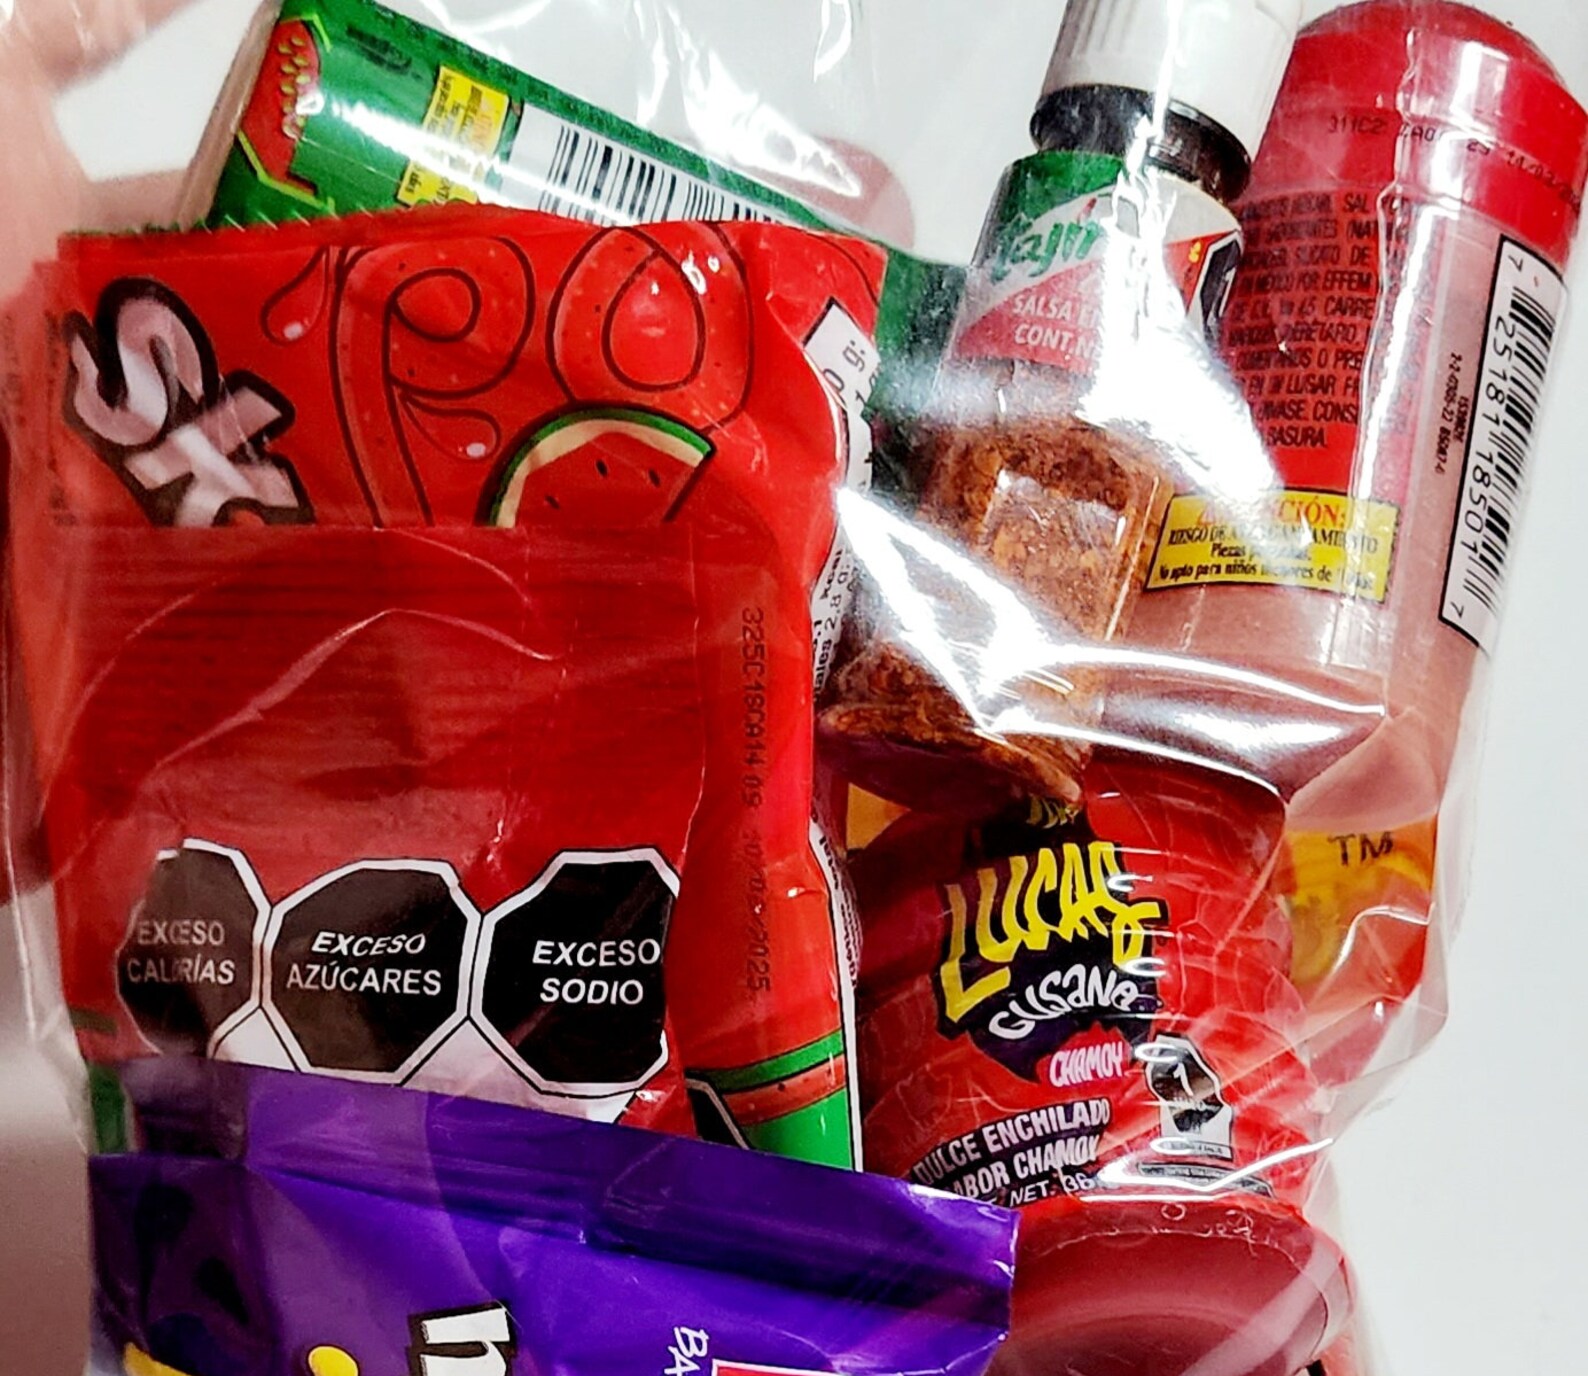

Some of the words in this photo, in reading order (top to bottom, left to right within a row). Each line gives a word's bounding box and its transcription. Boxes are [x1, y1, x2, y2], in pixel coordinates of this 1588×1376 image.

[1506, 254, 1524, 273] 7
[1012, 293, 1072, 321] SALSA
[1482, 315, 1516, 426] 25181
[1459, 448, 1493, 557] 18501
[1449, 600, 1465, 619] 7
[1330, 831, 1395, 867] TM
[137, 918, 225, 947] EXCESO
[311, 930, 426, 957] EXCESO
[940, 841, 1161, 1024] LUCAS
[532, 939, 661, 968] EXCESO
[286, 959, 442, 996] AZÚCARES
[539, 979, 644, 1006] SODIO
[1049, 1040, 1125, 1088] CHAMOY
[982, 1097, 1111, 1154] ENCHILADO
[953, 1160, 1011, 1200] ABOR
[1012, 1134, 1101, 1180] CHAMOY
